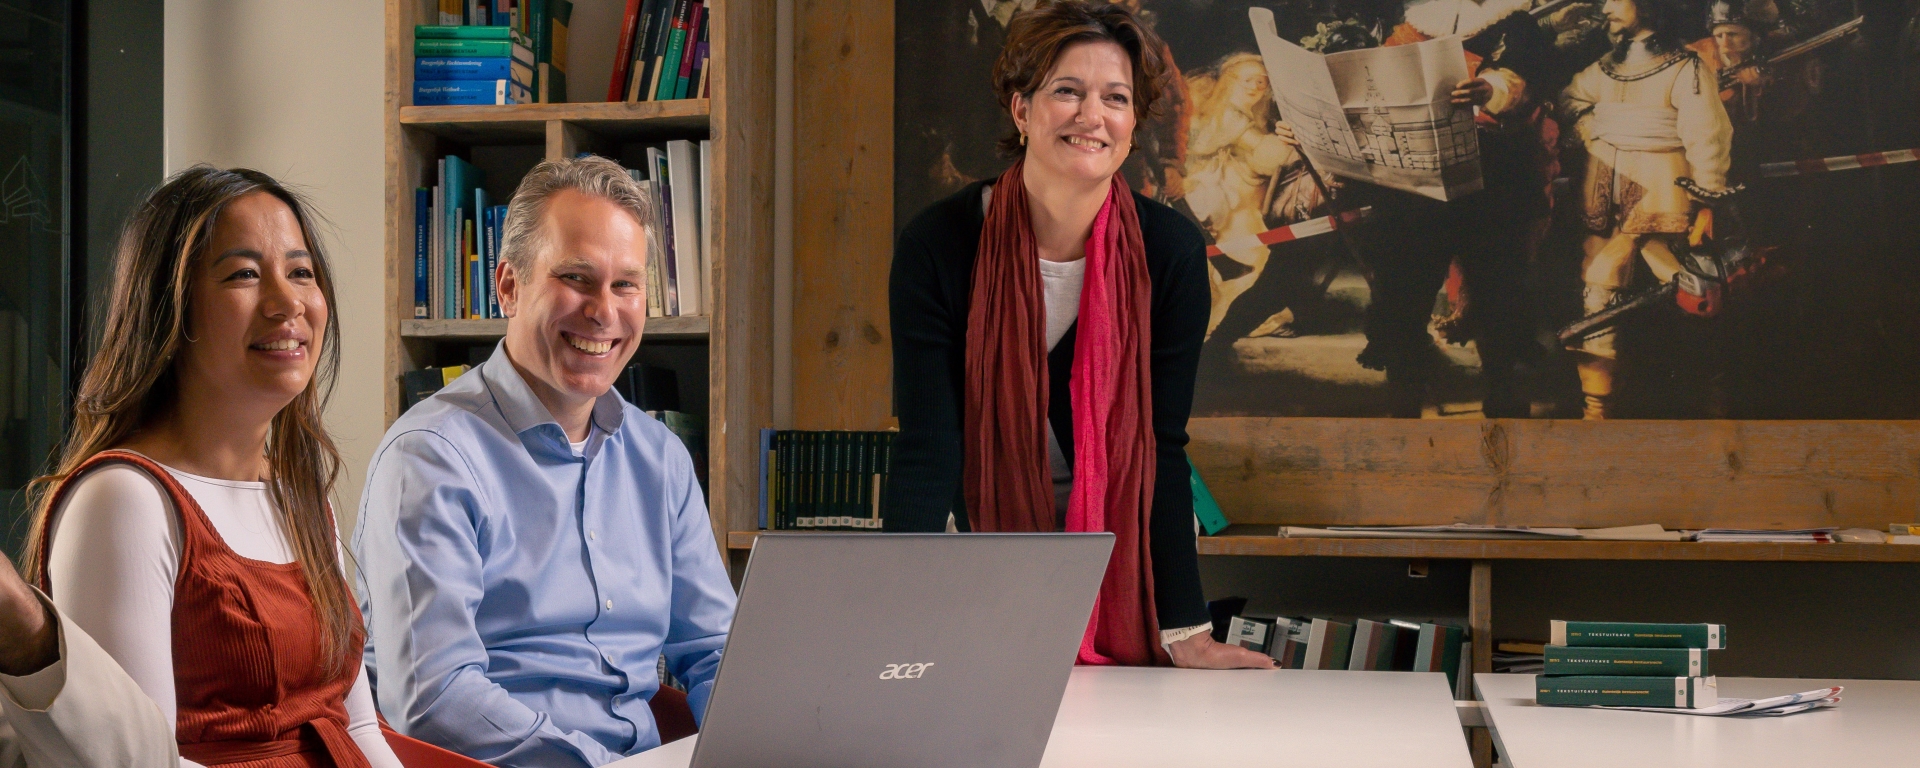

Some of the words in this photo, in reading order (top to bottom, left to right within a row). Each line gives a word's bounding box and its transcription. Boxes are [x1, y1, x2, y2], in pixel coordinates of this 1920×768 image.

[486, 210, 492, 219] 1
[487, 226, 495, 260] WONINGWET
[489, 260, 495, 268] EN
[879, 662, 935, 680] acer
